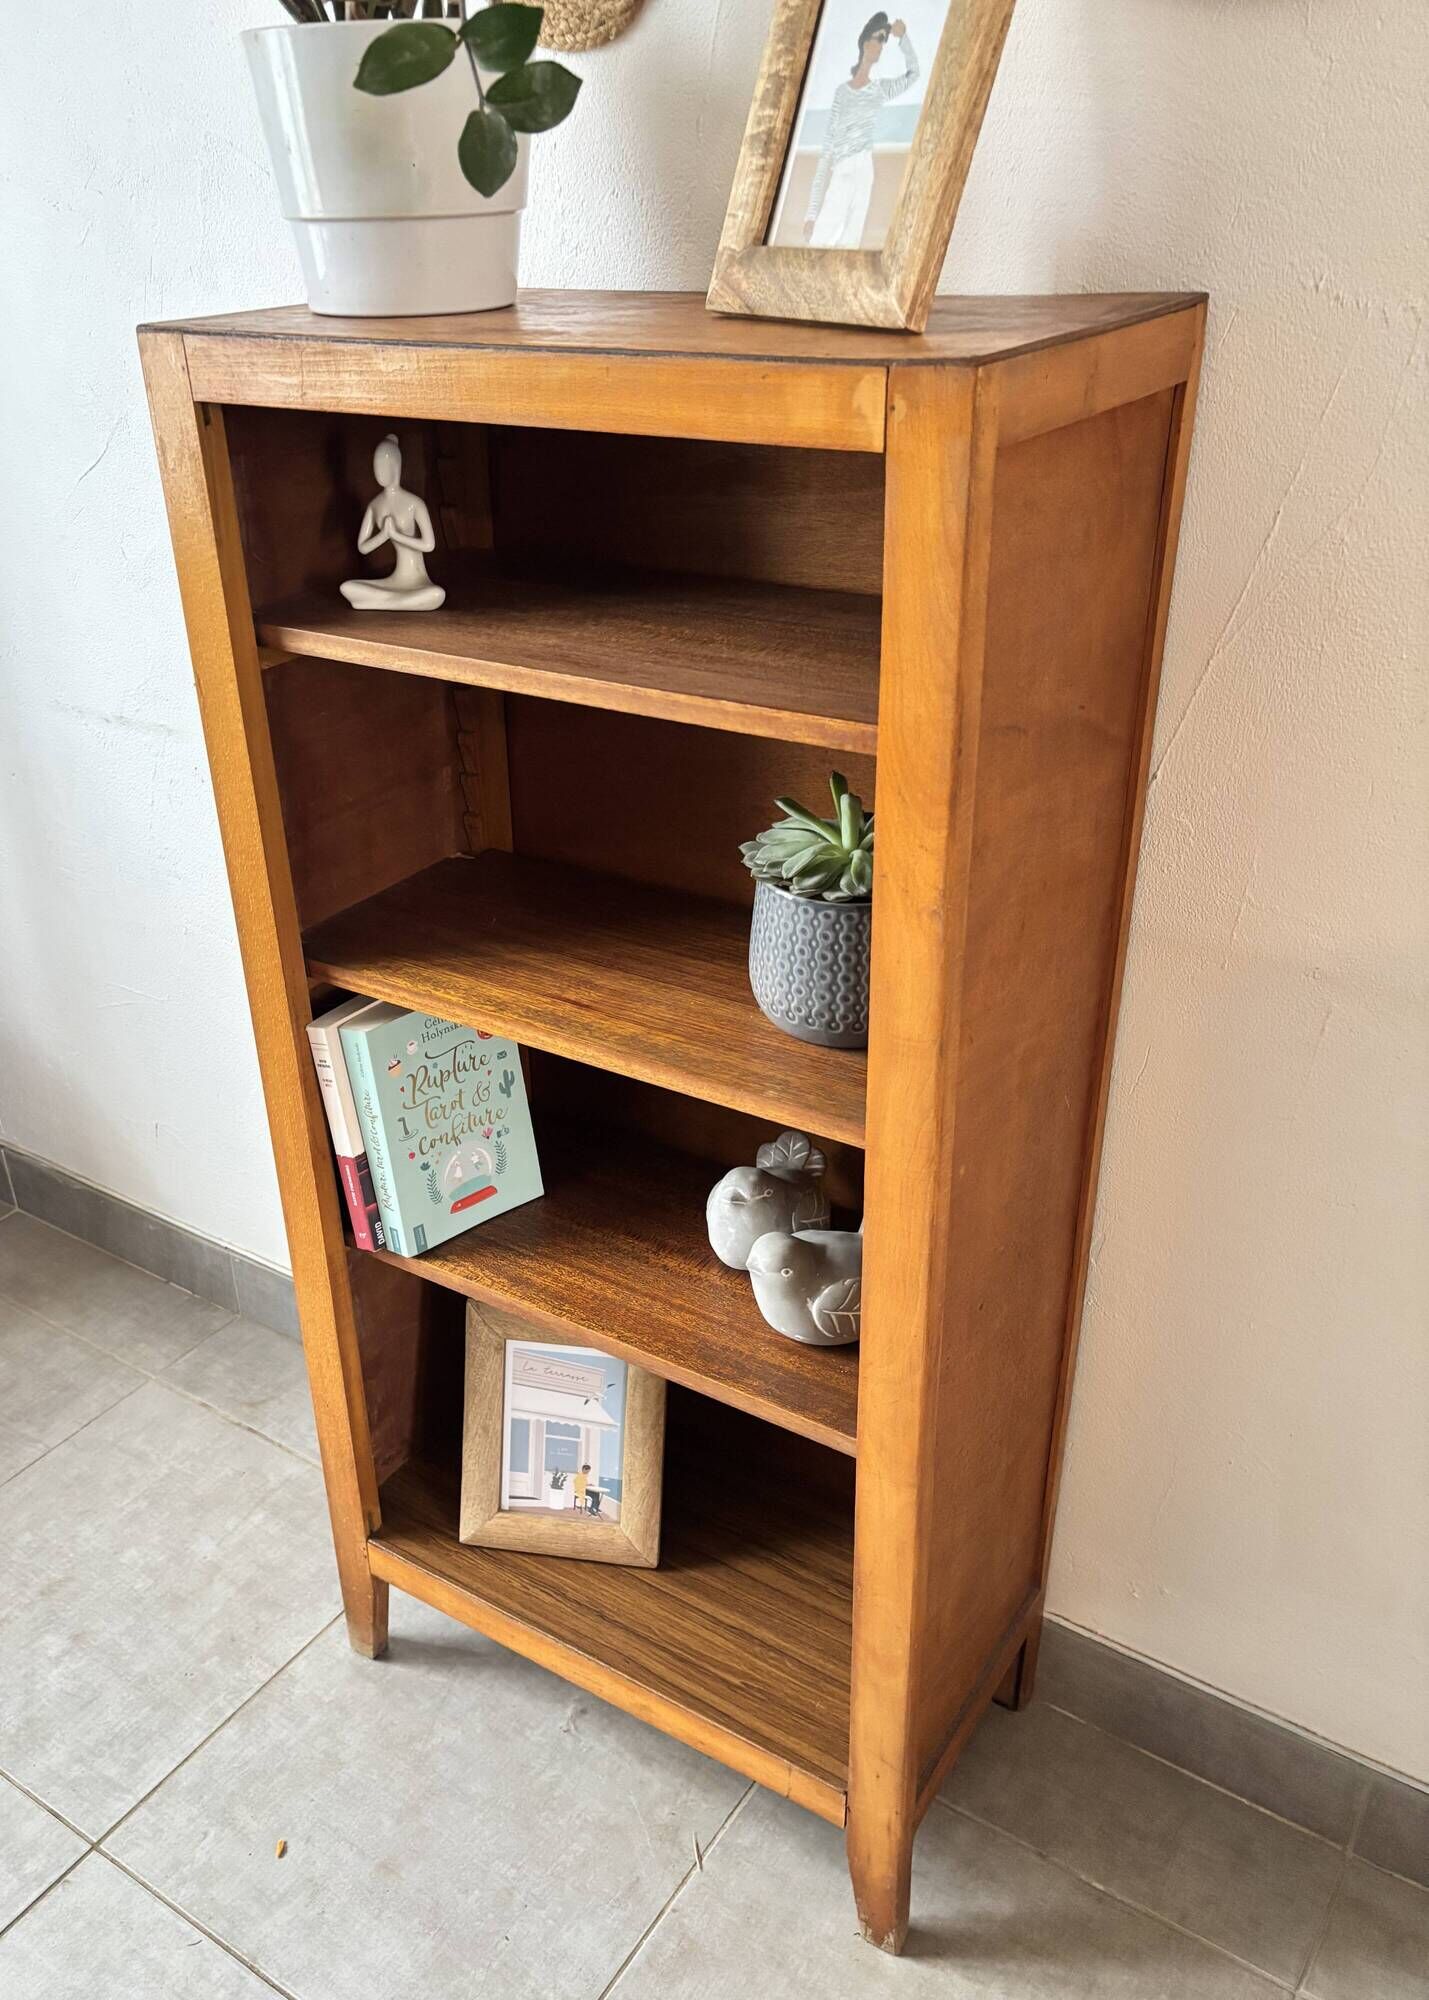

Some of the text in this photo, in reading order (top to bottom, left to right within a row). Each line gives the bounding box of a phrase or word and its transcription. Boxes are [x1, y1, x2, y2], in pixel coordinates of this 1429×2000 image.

[424, 1016, 447, 1029] Cél
[406, 1040, 491, 1105] Rupture
[403, 1080, 491, 1129] Tarot &
[375, 1221, 386, 1245] DAVID
